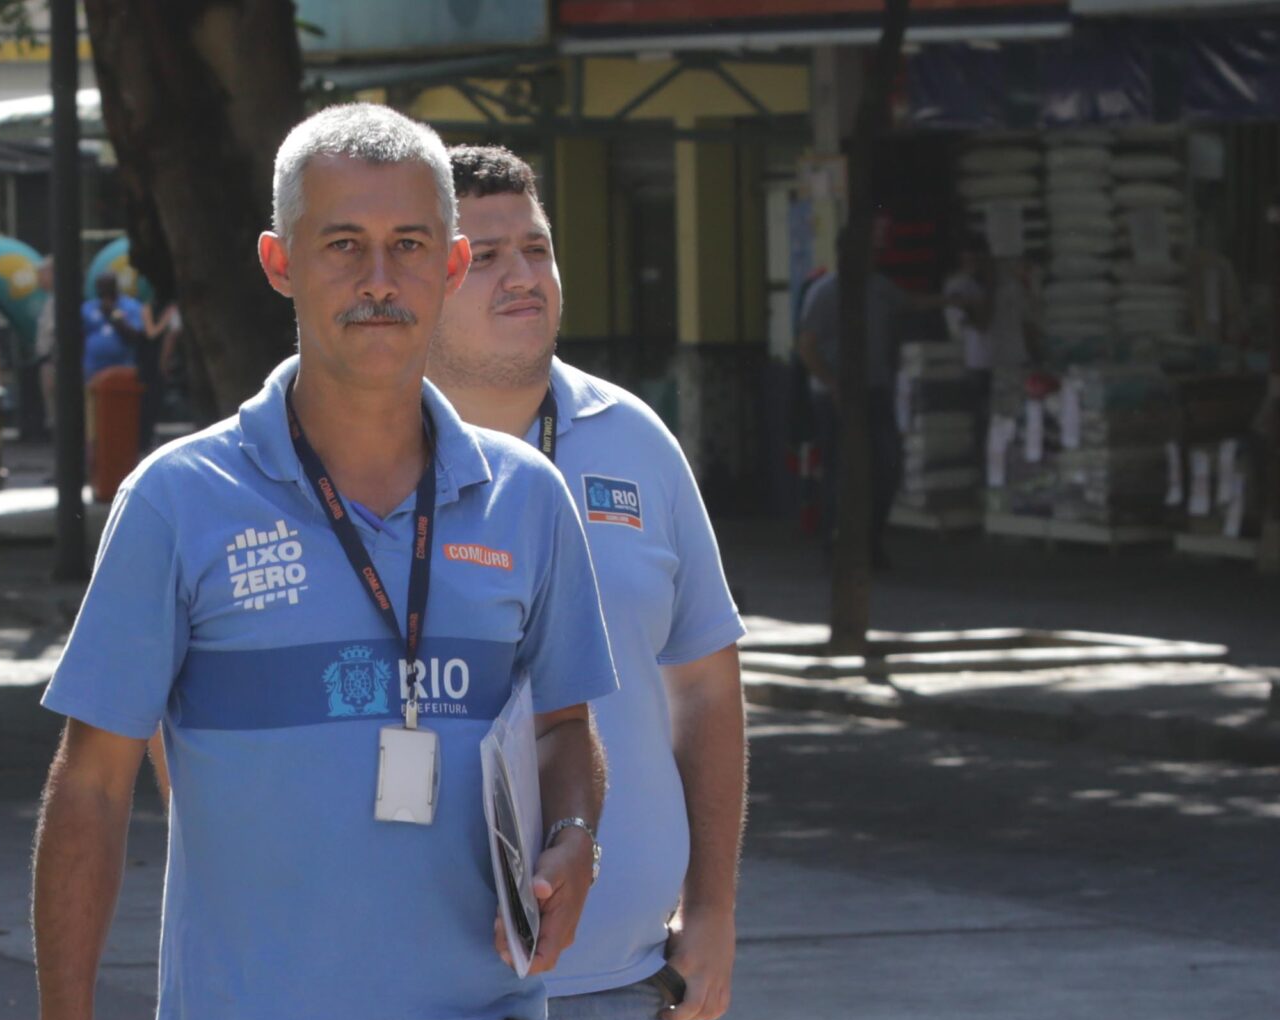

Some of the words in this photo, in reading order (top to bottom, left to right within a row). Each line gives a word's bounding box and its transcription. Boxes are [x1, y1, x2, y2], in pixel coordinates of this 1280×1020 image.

[319, 477, 344, 519] COMLURB
[611, 489, 637, 507] RIO
[416, 516, 428, 559] COMLURB
[227, 541, 302, 573] LIXO
[449, 545, 509, 568] COMLURB
[231, 563, 306, 598] ZERO
[362, 567, 389, 609] COMLURB
[398, 657, 470, 700] RIO
[400, 702, 468, 715] PEFEITURA
